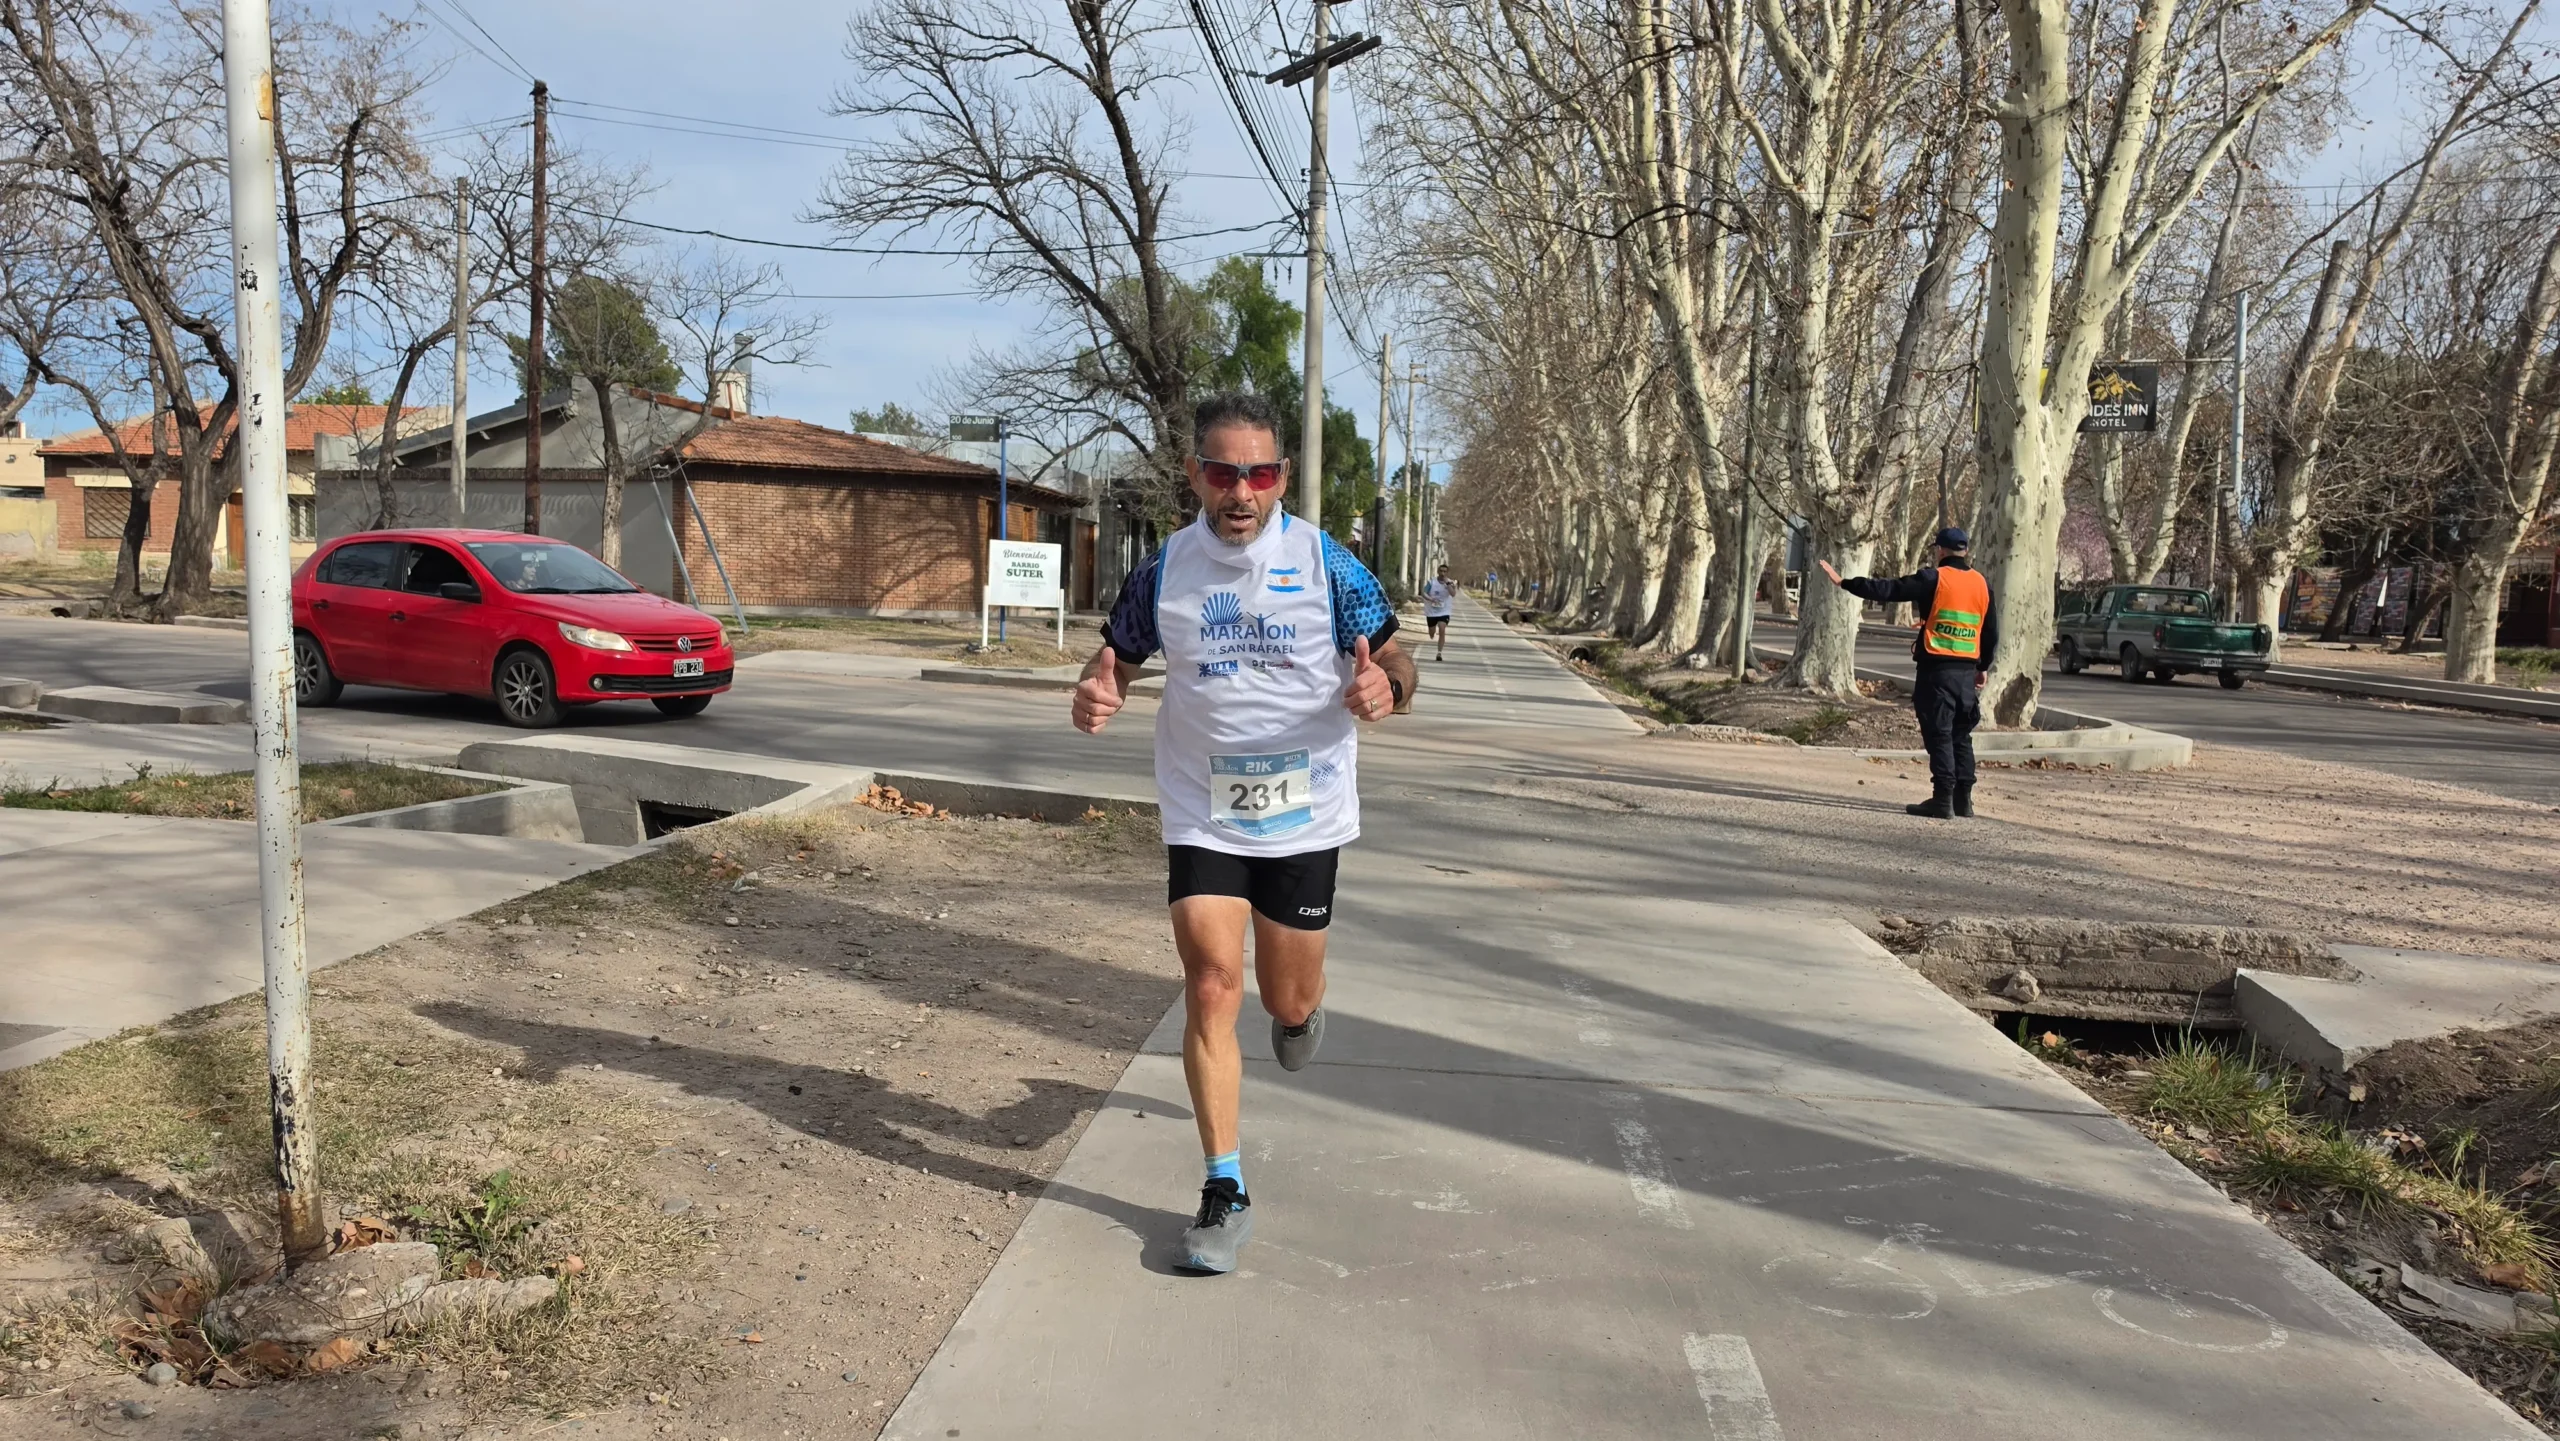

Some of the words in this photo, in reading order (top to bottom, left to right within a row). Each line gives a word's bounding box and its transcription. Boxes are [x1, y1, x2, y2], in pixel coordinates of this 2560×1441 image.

[2089, 404, 2121, 417] DES
[2124, 403, 2149, 416] INN
[950, 415, 961, 424] 20
[962, 416, 972, 424] de
[972, 416, 995, 425] Junio
[1003, 548, 1048, 560] Bienvenidos
[1011, 561, 1040, 569] BARRIO
[1006, 568, 1044, 579] SUTER
[1200, 620, 1297, 642] MARATON
[1935, 622, 1976, 638] POLICIA
[1208, 648, 1216, 656] DE
[1219, 643, 1246, 655] SAN
[1248, 643, 1295, 655] RAFAEL
[1211, 660, 1238, 670] UTN
[1245, 760, 1273, 773] 21K
[1229, 779, 1289, 811] 231
[1298, 905, 1328, 916] DSX
